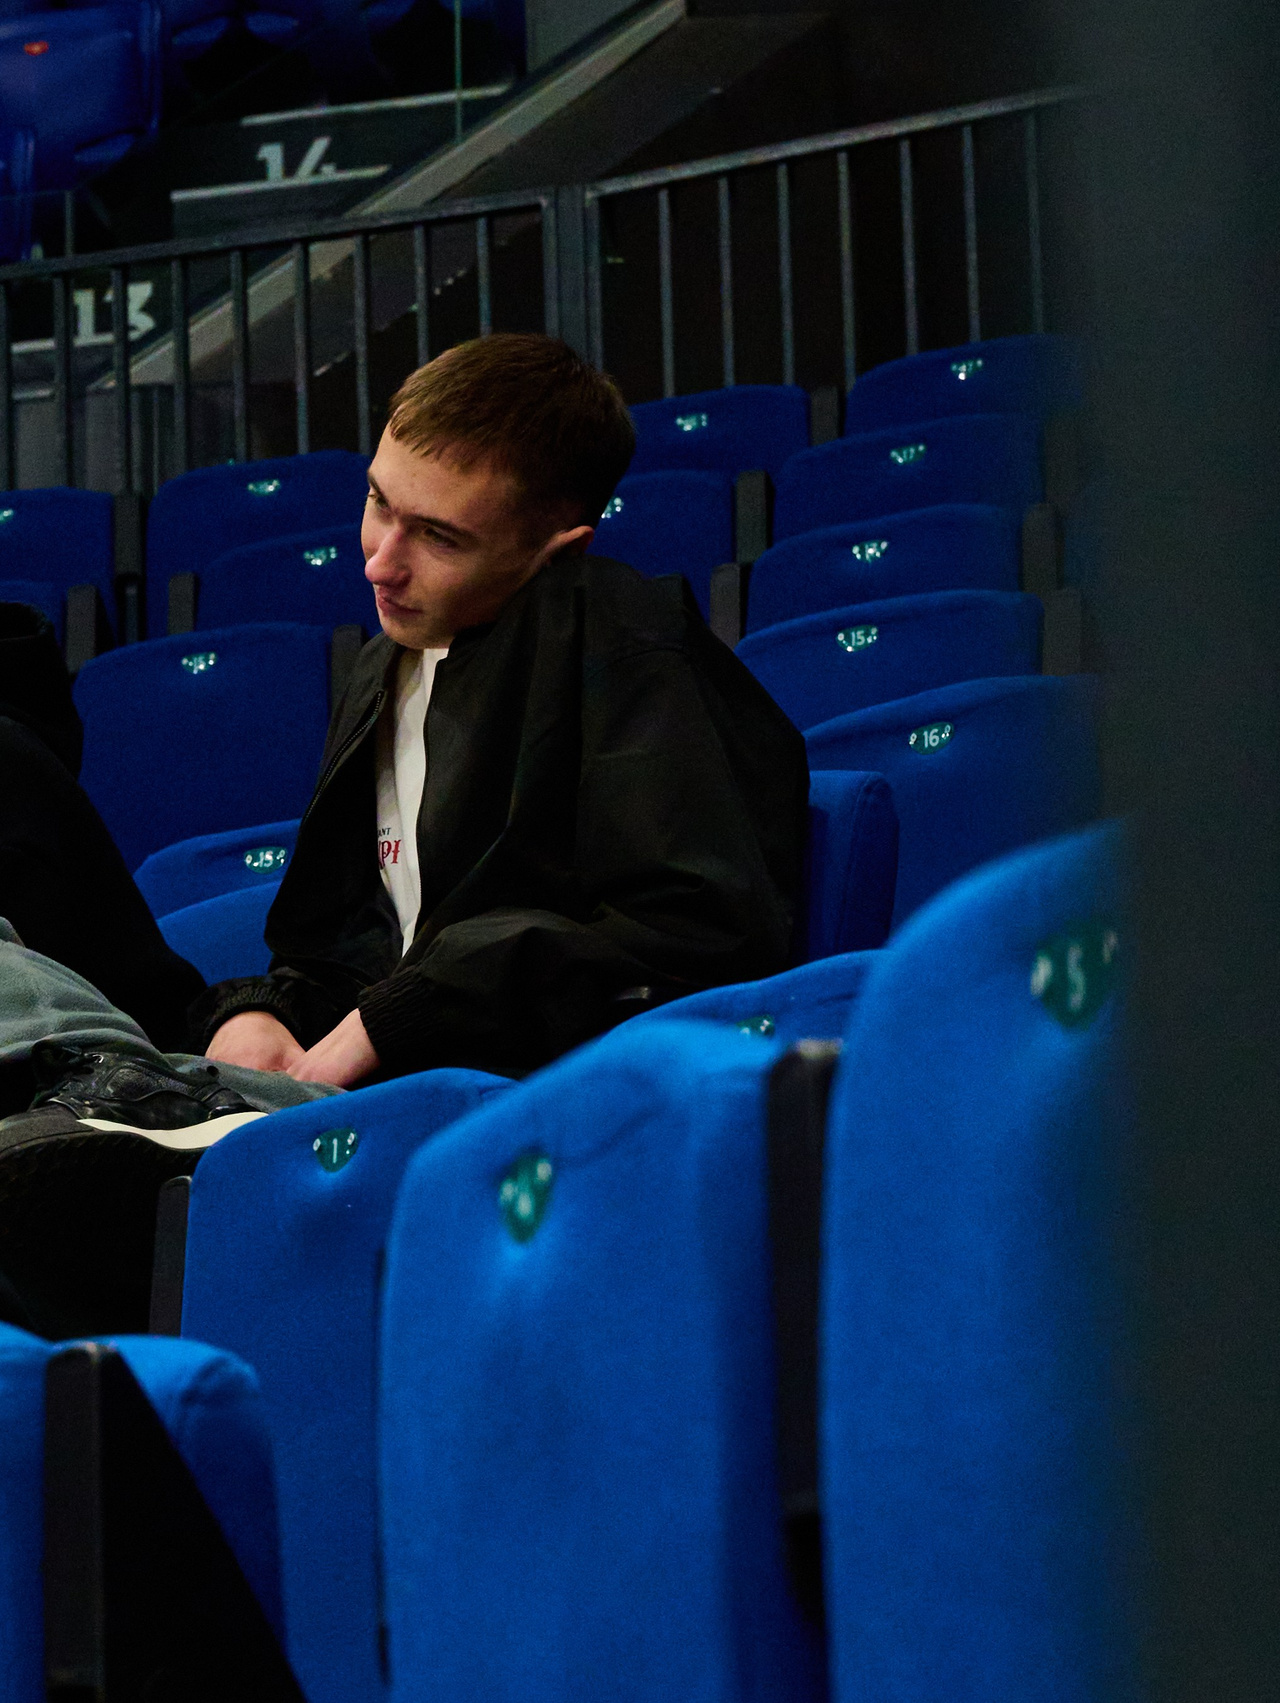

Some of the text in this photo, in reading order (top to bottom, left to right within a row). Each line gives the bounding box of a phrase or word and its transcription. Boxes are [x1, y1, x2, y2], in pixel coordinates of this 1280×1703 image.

[255, 136, 336, 182] 14
[73, 280, 155, 343] 13
[851, 631, 865, 646] 15
[924, 728, 940, 748] 16
[259, 850, 274, 868] 15
